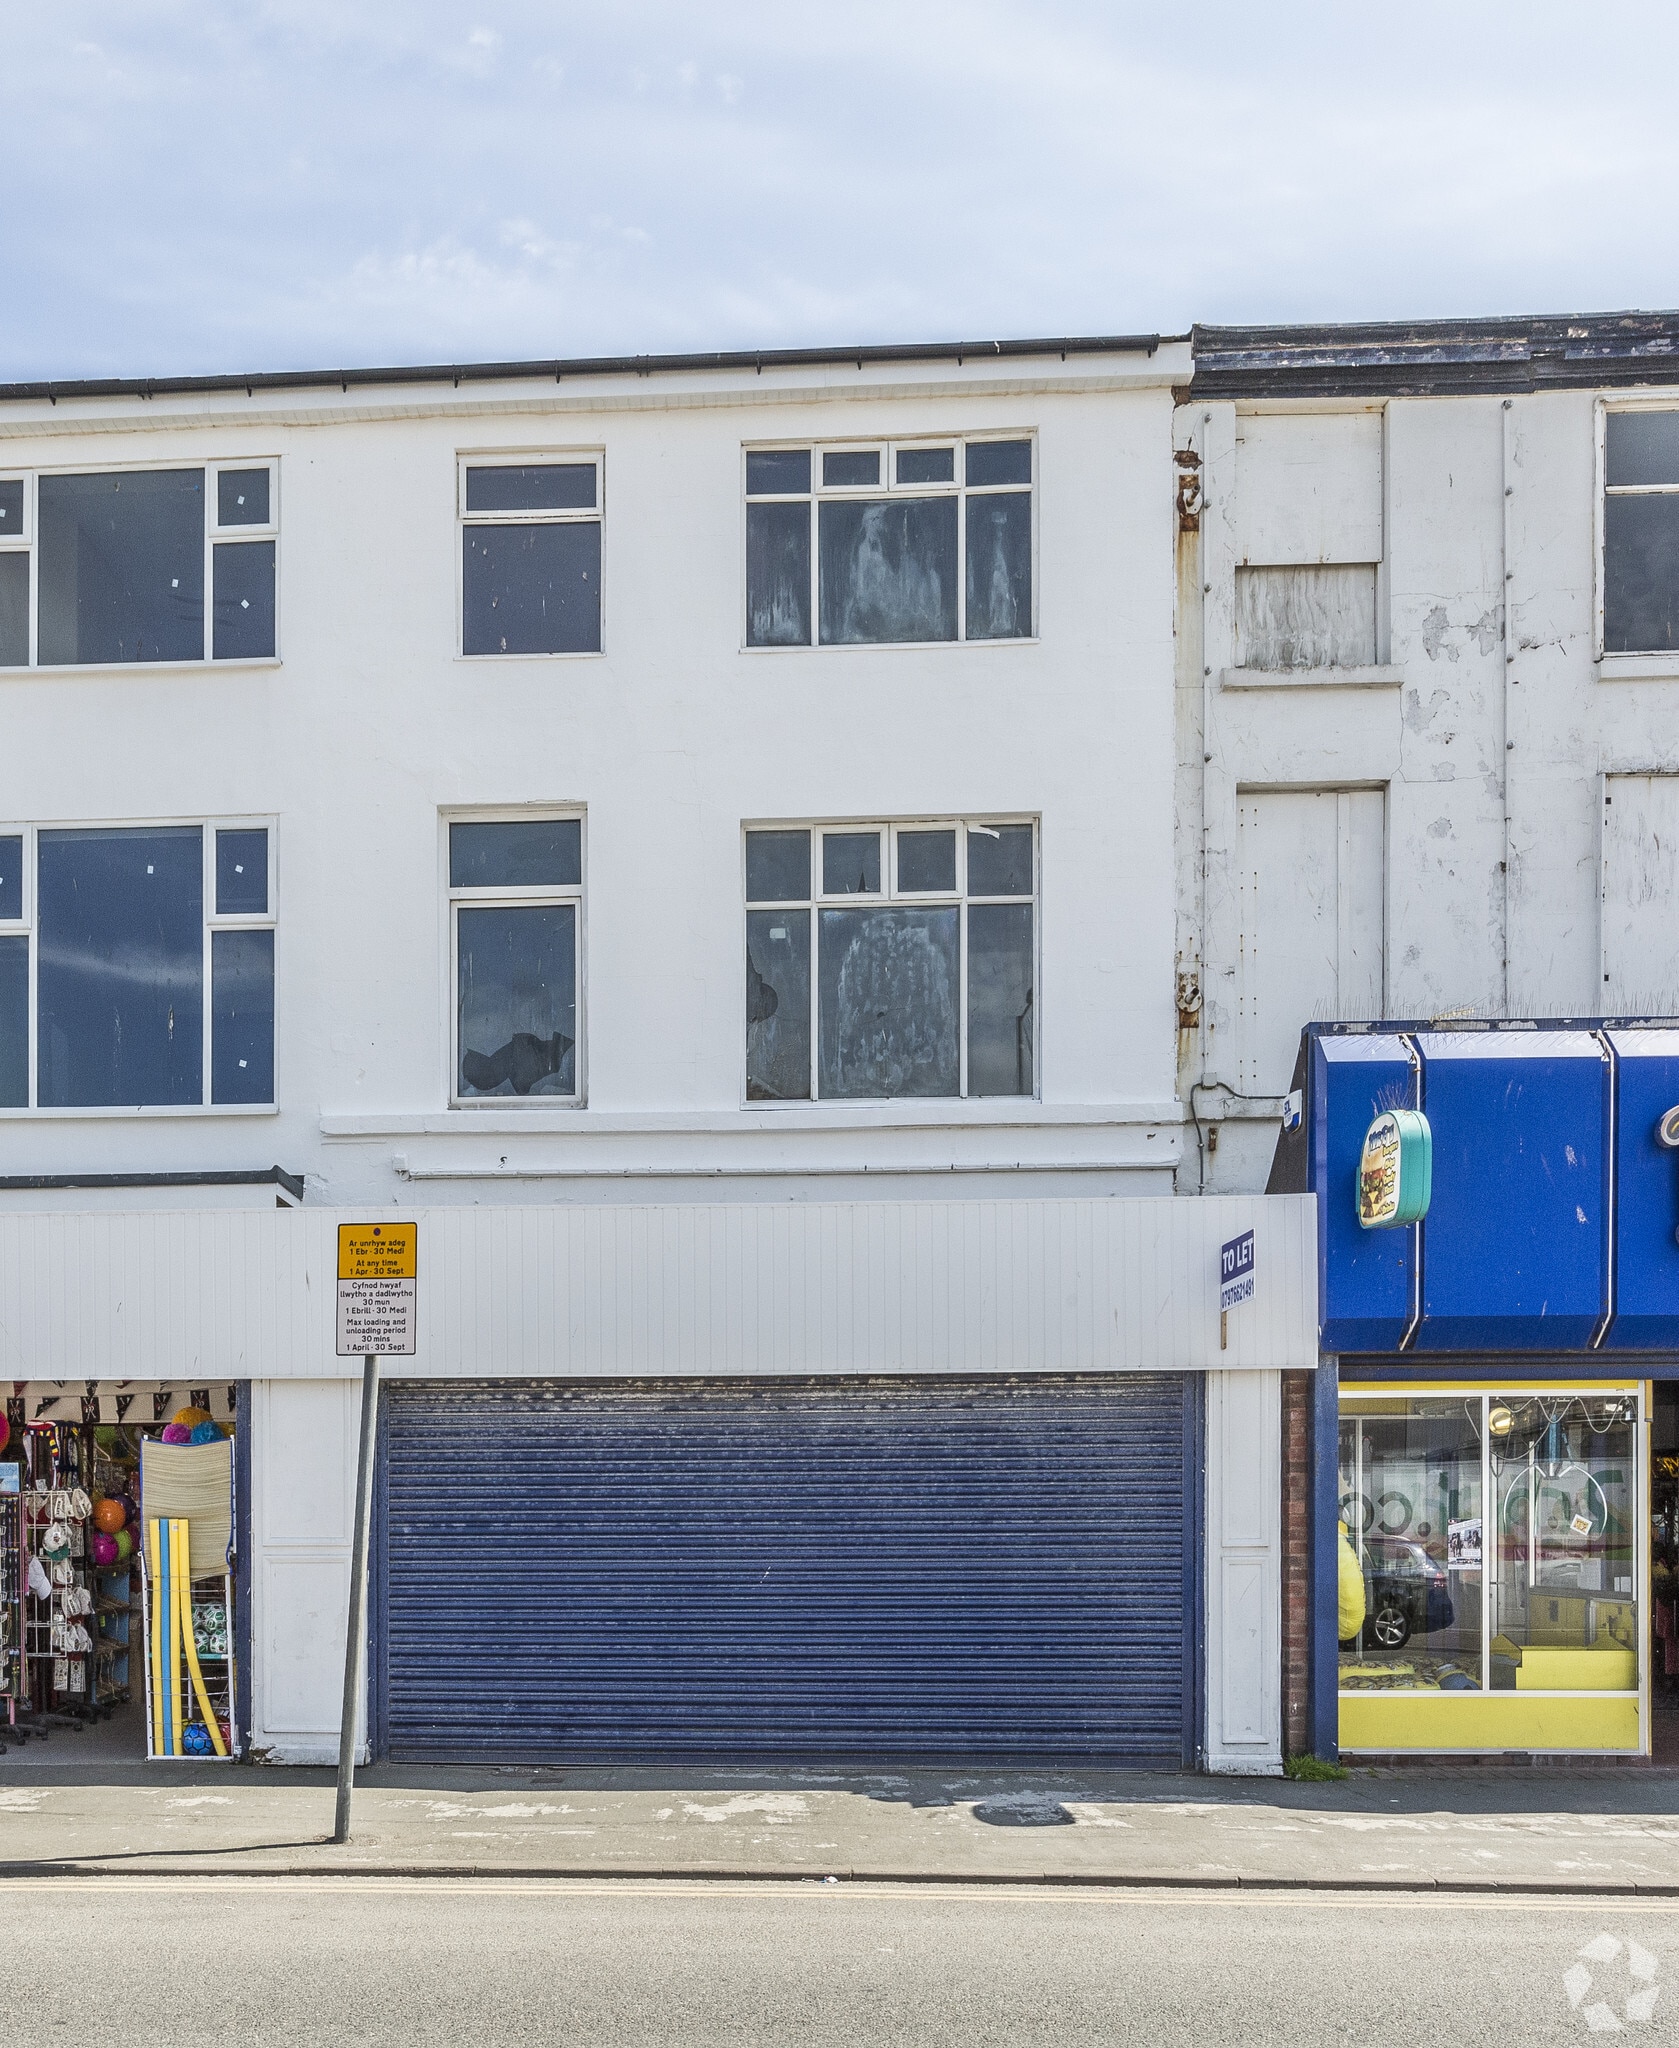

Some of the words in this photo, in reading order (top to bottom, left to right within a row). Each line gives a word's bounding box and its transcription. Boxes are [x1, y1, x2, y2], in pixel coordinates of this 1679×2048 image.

[1223, 1248, 1234, 1274] TO
[1237, 1238, 1253, 1267] LET
[380, 1282, 401, 1290] hwyaf
